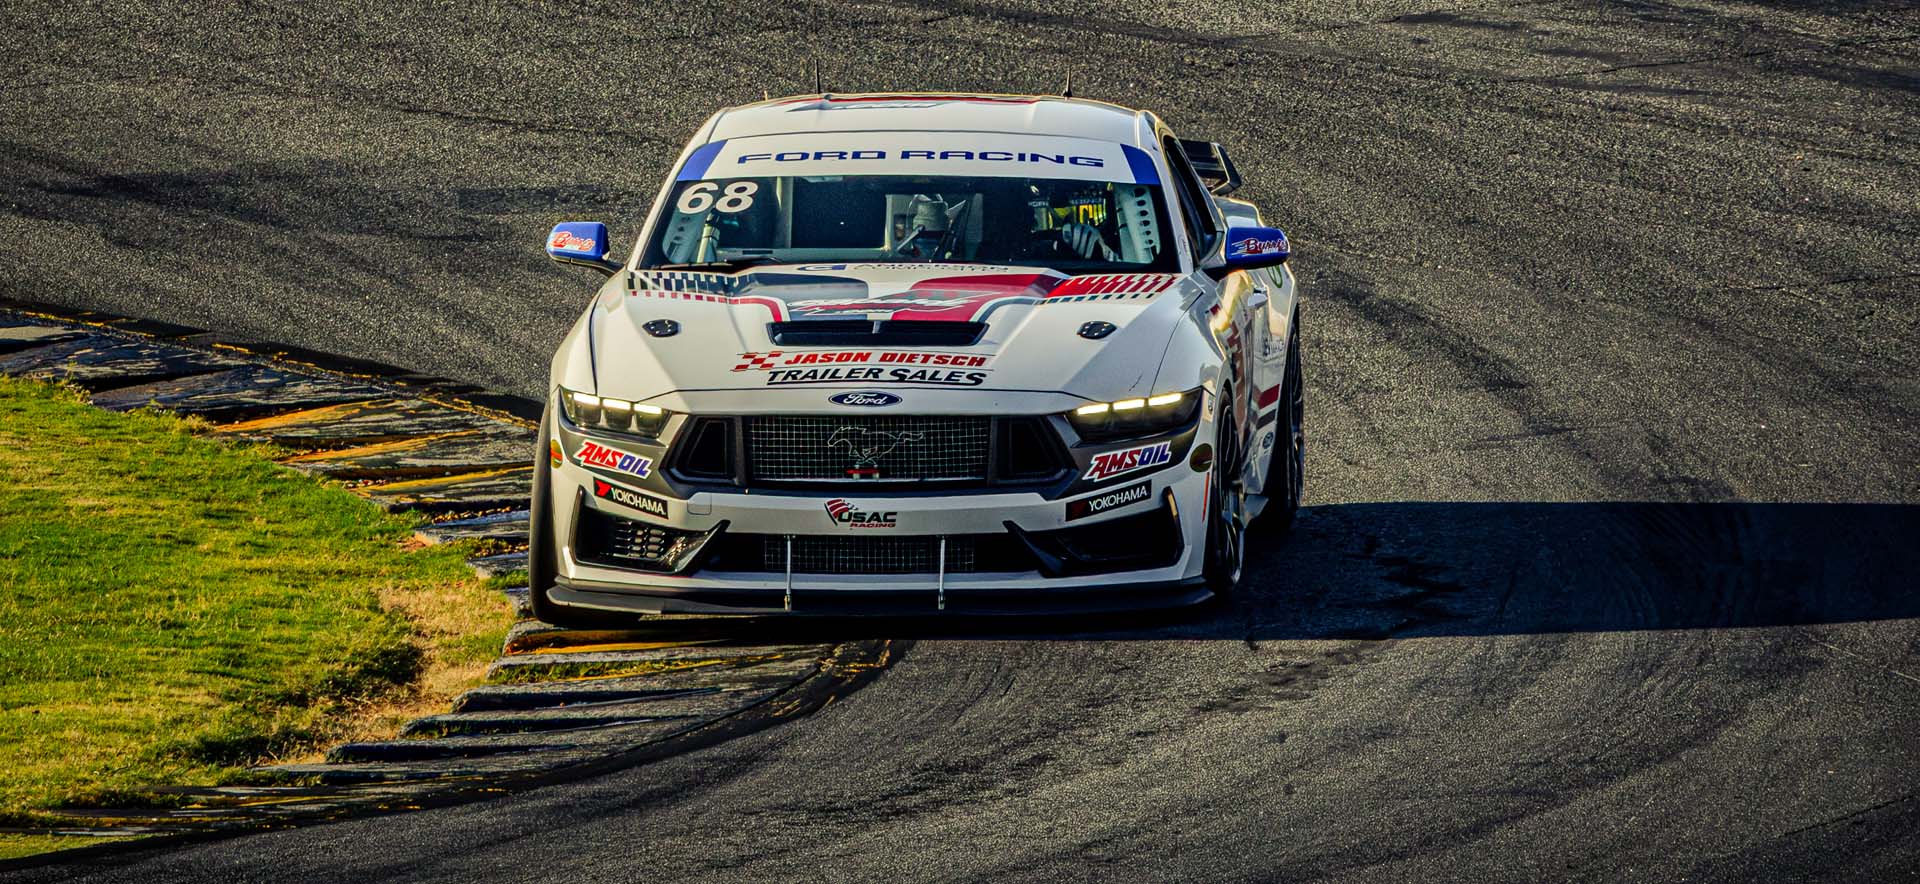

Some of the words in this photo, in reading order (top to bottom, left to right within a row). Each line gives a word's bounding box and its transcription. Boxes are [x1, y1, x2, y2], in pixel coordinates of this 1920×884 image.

[737, 150, 887, 164] FORD
[900, 150, 1104, 168] RACING
[677, 181, 758, 214] 68
[784, 352, 872, 365] JASON
[879, 352, 987, 367] DIETSCH
[768, 367, 882, 382] TRAILER
[889, 368, 987, 386] SALES
[843, 393, 888, 406] Ford
[577, 441, 652, 477] AMSOIL
[1088, 443, 1171, 480] AMSOIL
[611, 487, 666, 515] YOKOHAMA
[1089, 486, 1148, 512] YOKOHAMA
[838, 511, 898, 523] USAC
